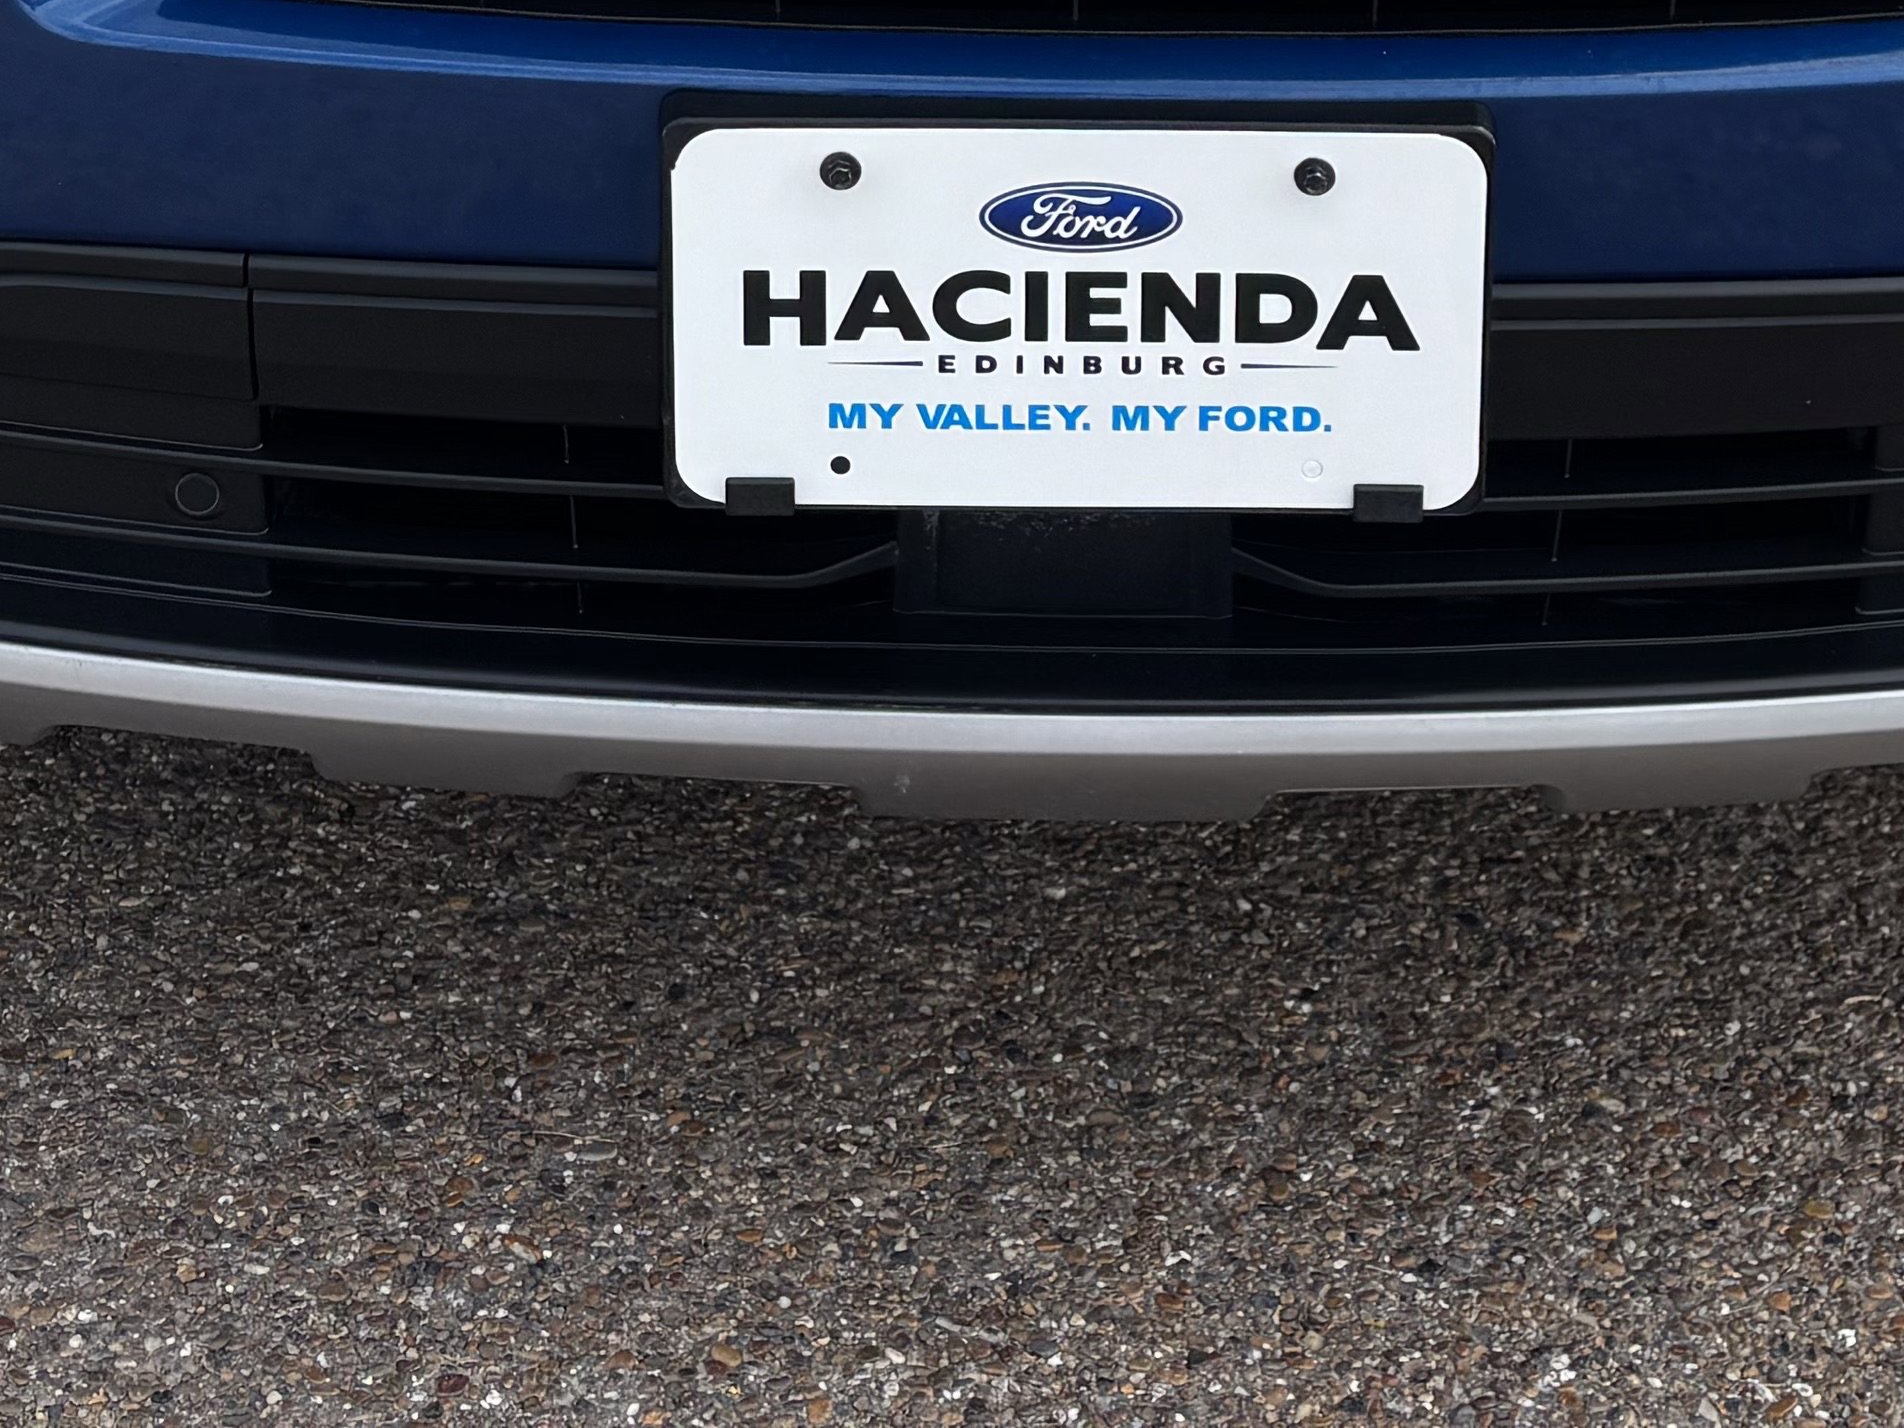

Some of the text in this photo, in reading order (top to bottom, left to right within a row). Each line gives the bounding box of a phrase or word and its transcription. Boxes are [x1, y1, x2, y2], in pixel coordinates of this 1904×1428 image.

[1019, 192, 1139, 241] Ford
[741, 269, 1421, 352] HACIENDA
[937, 354, 1227, 377] EDINBURG
[827, 402, 1333, 434] MY VALLEY. MY FORD.
